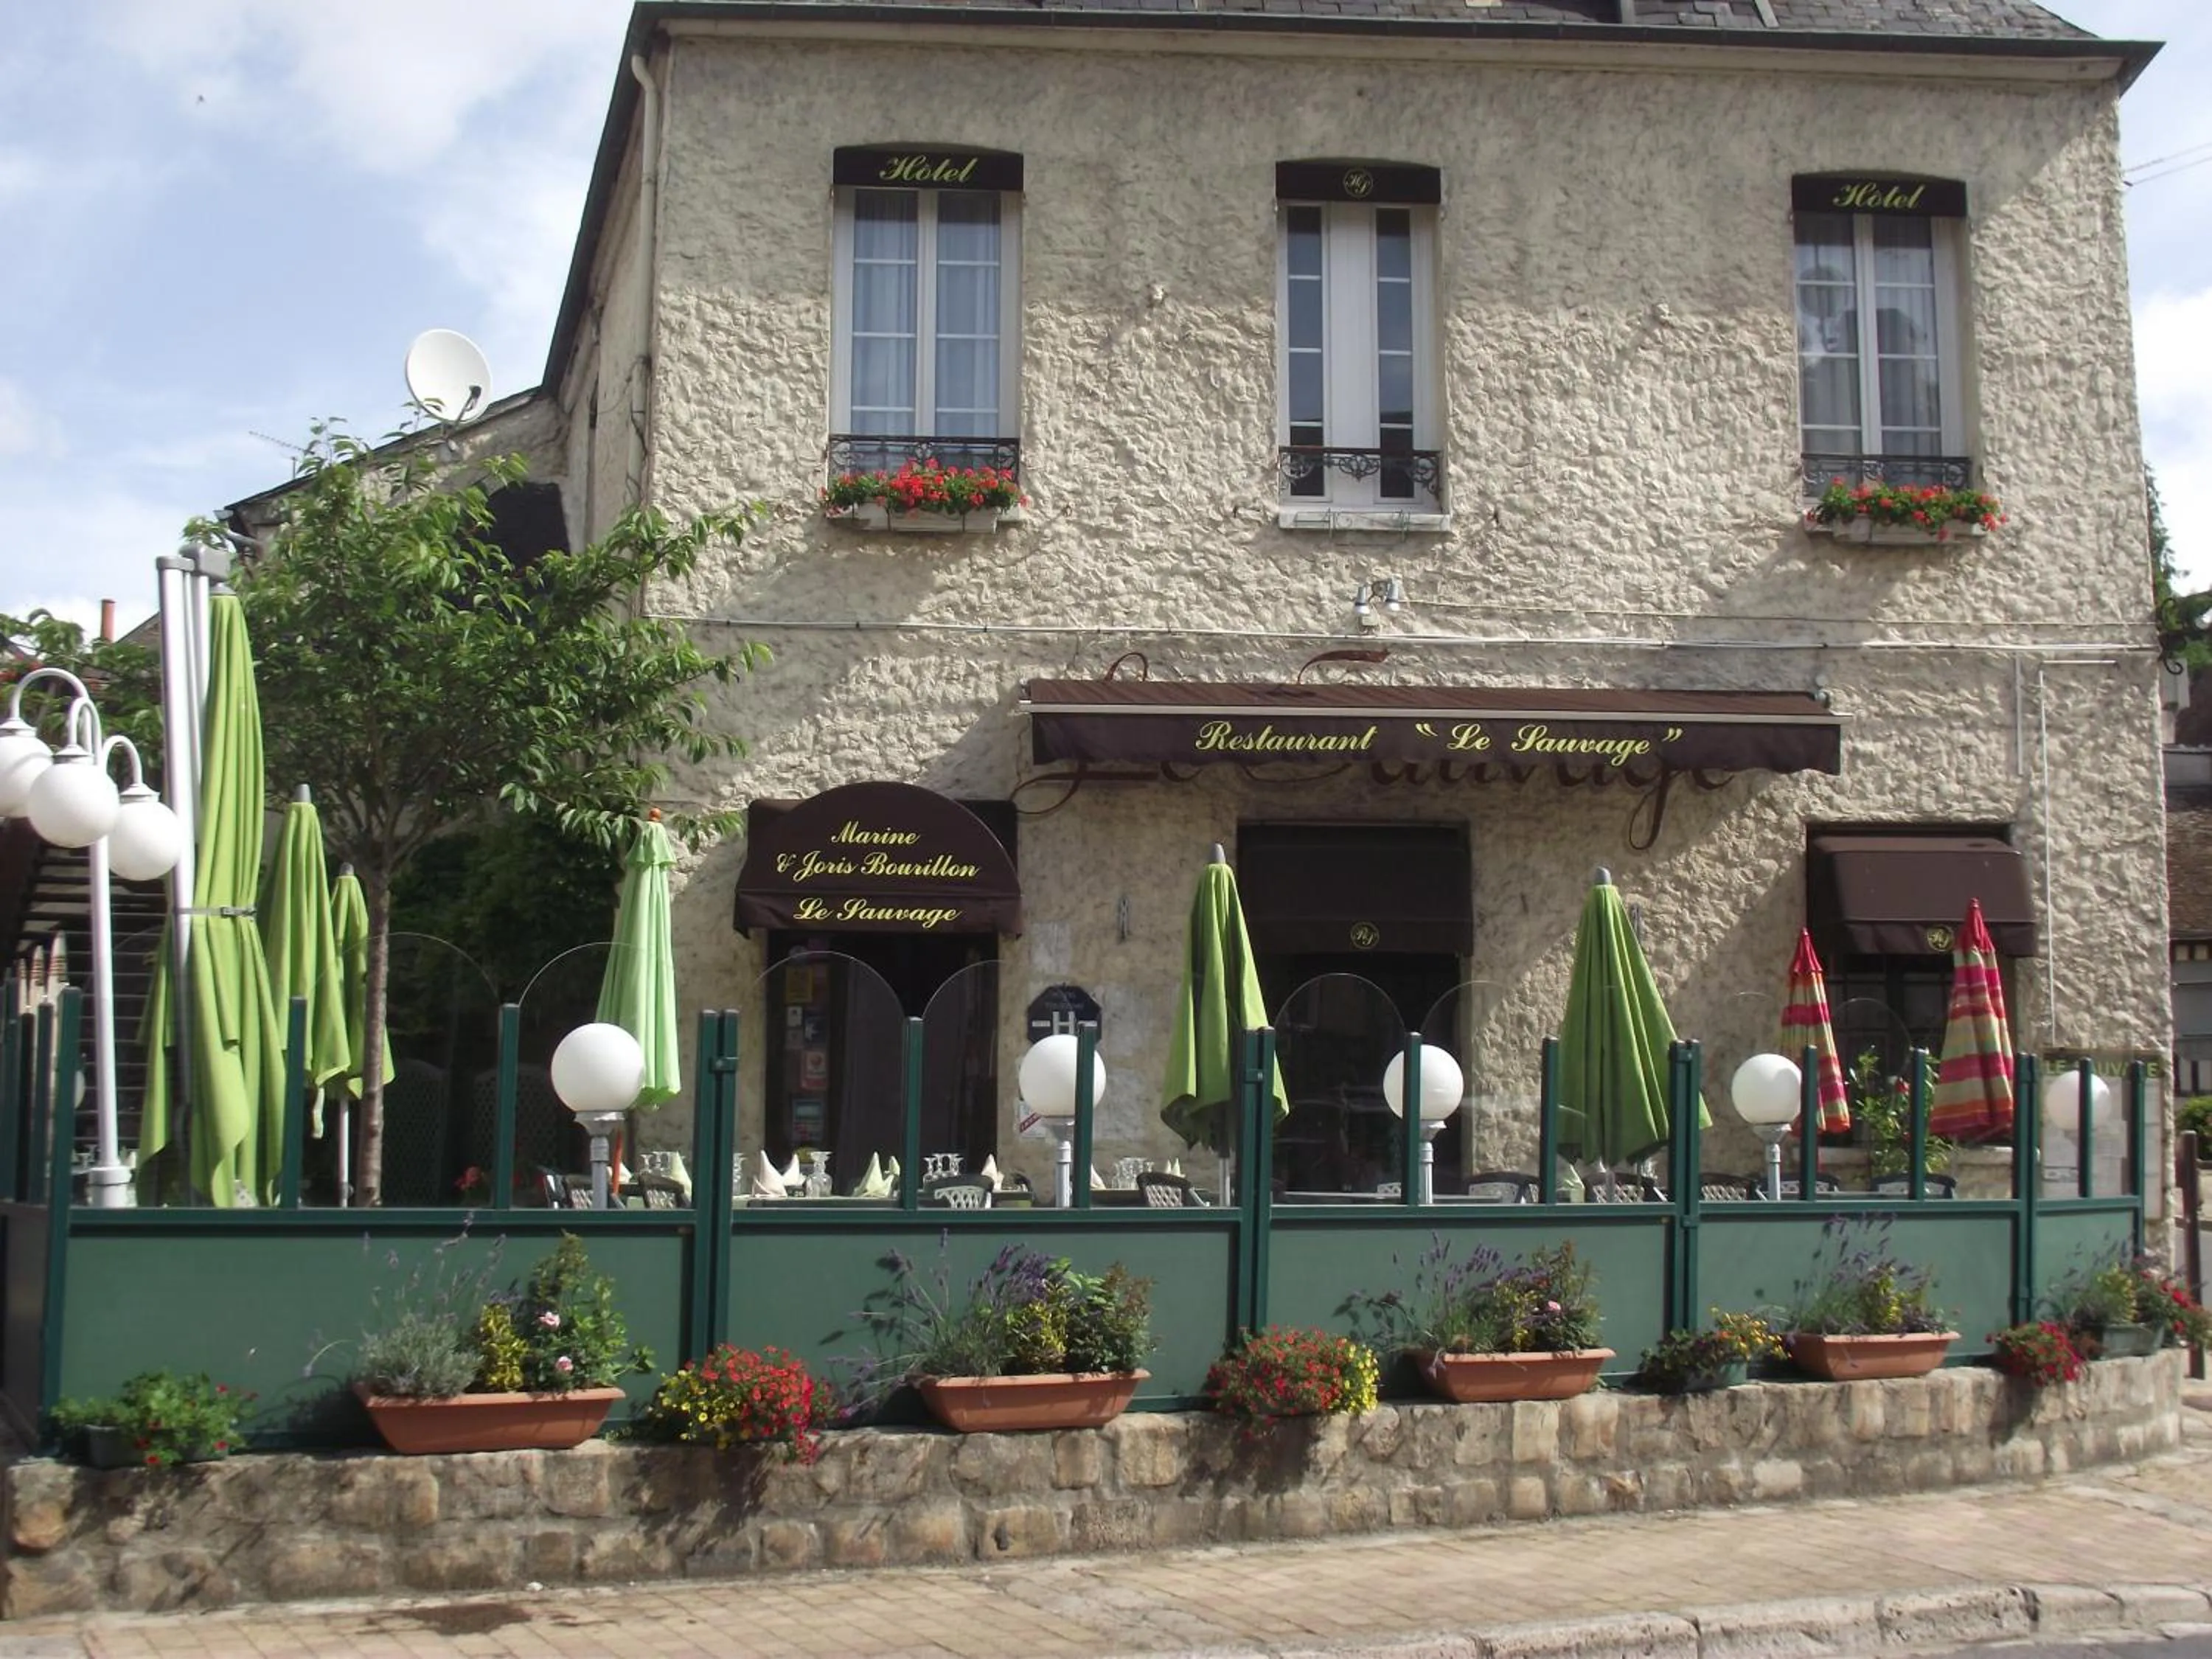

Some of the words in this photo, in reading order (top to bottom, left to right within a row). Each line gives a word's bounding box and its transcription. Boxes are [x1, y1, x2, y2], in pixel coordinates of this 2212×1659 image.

[1195, 720, 1377, 751] Restaurant
[831, 820, 921, 844] Marine
[793, 850, 858, 882] Joris
[860, 852, 981, 877] Bourillon
[793, 897, 832, 921] Le
[836, 898, 962, 929] Sauvage
